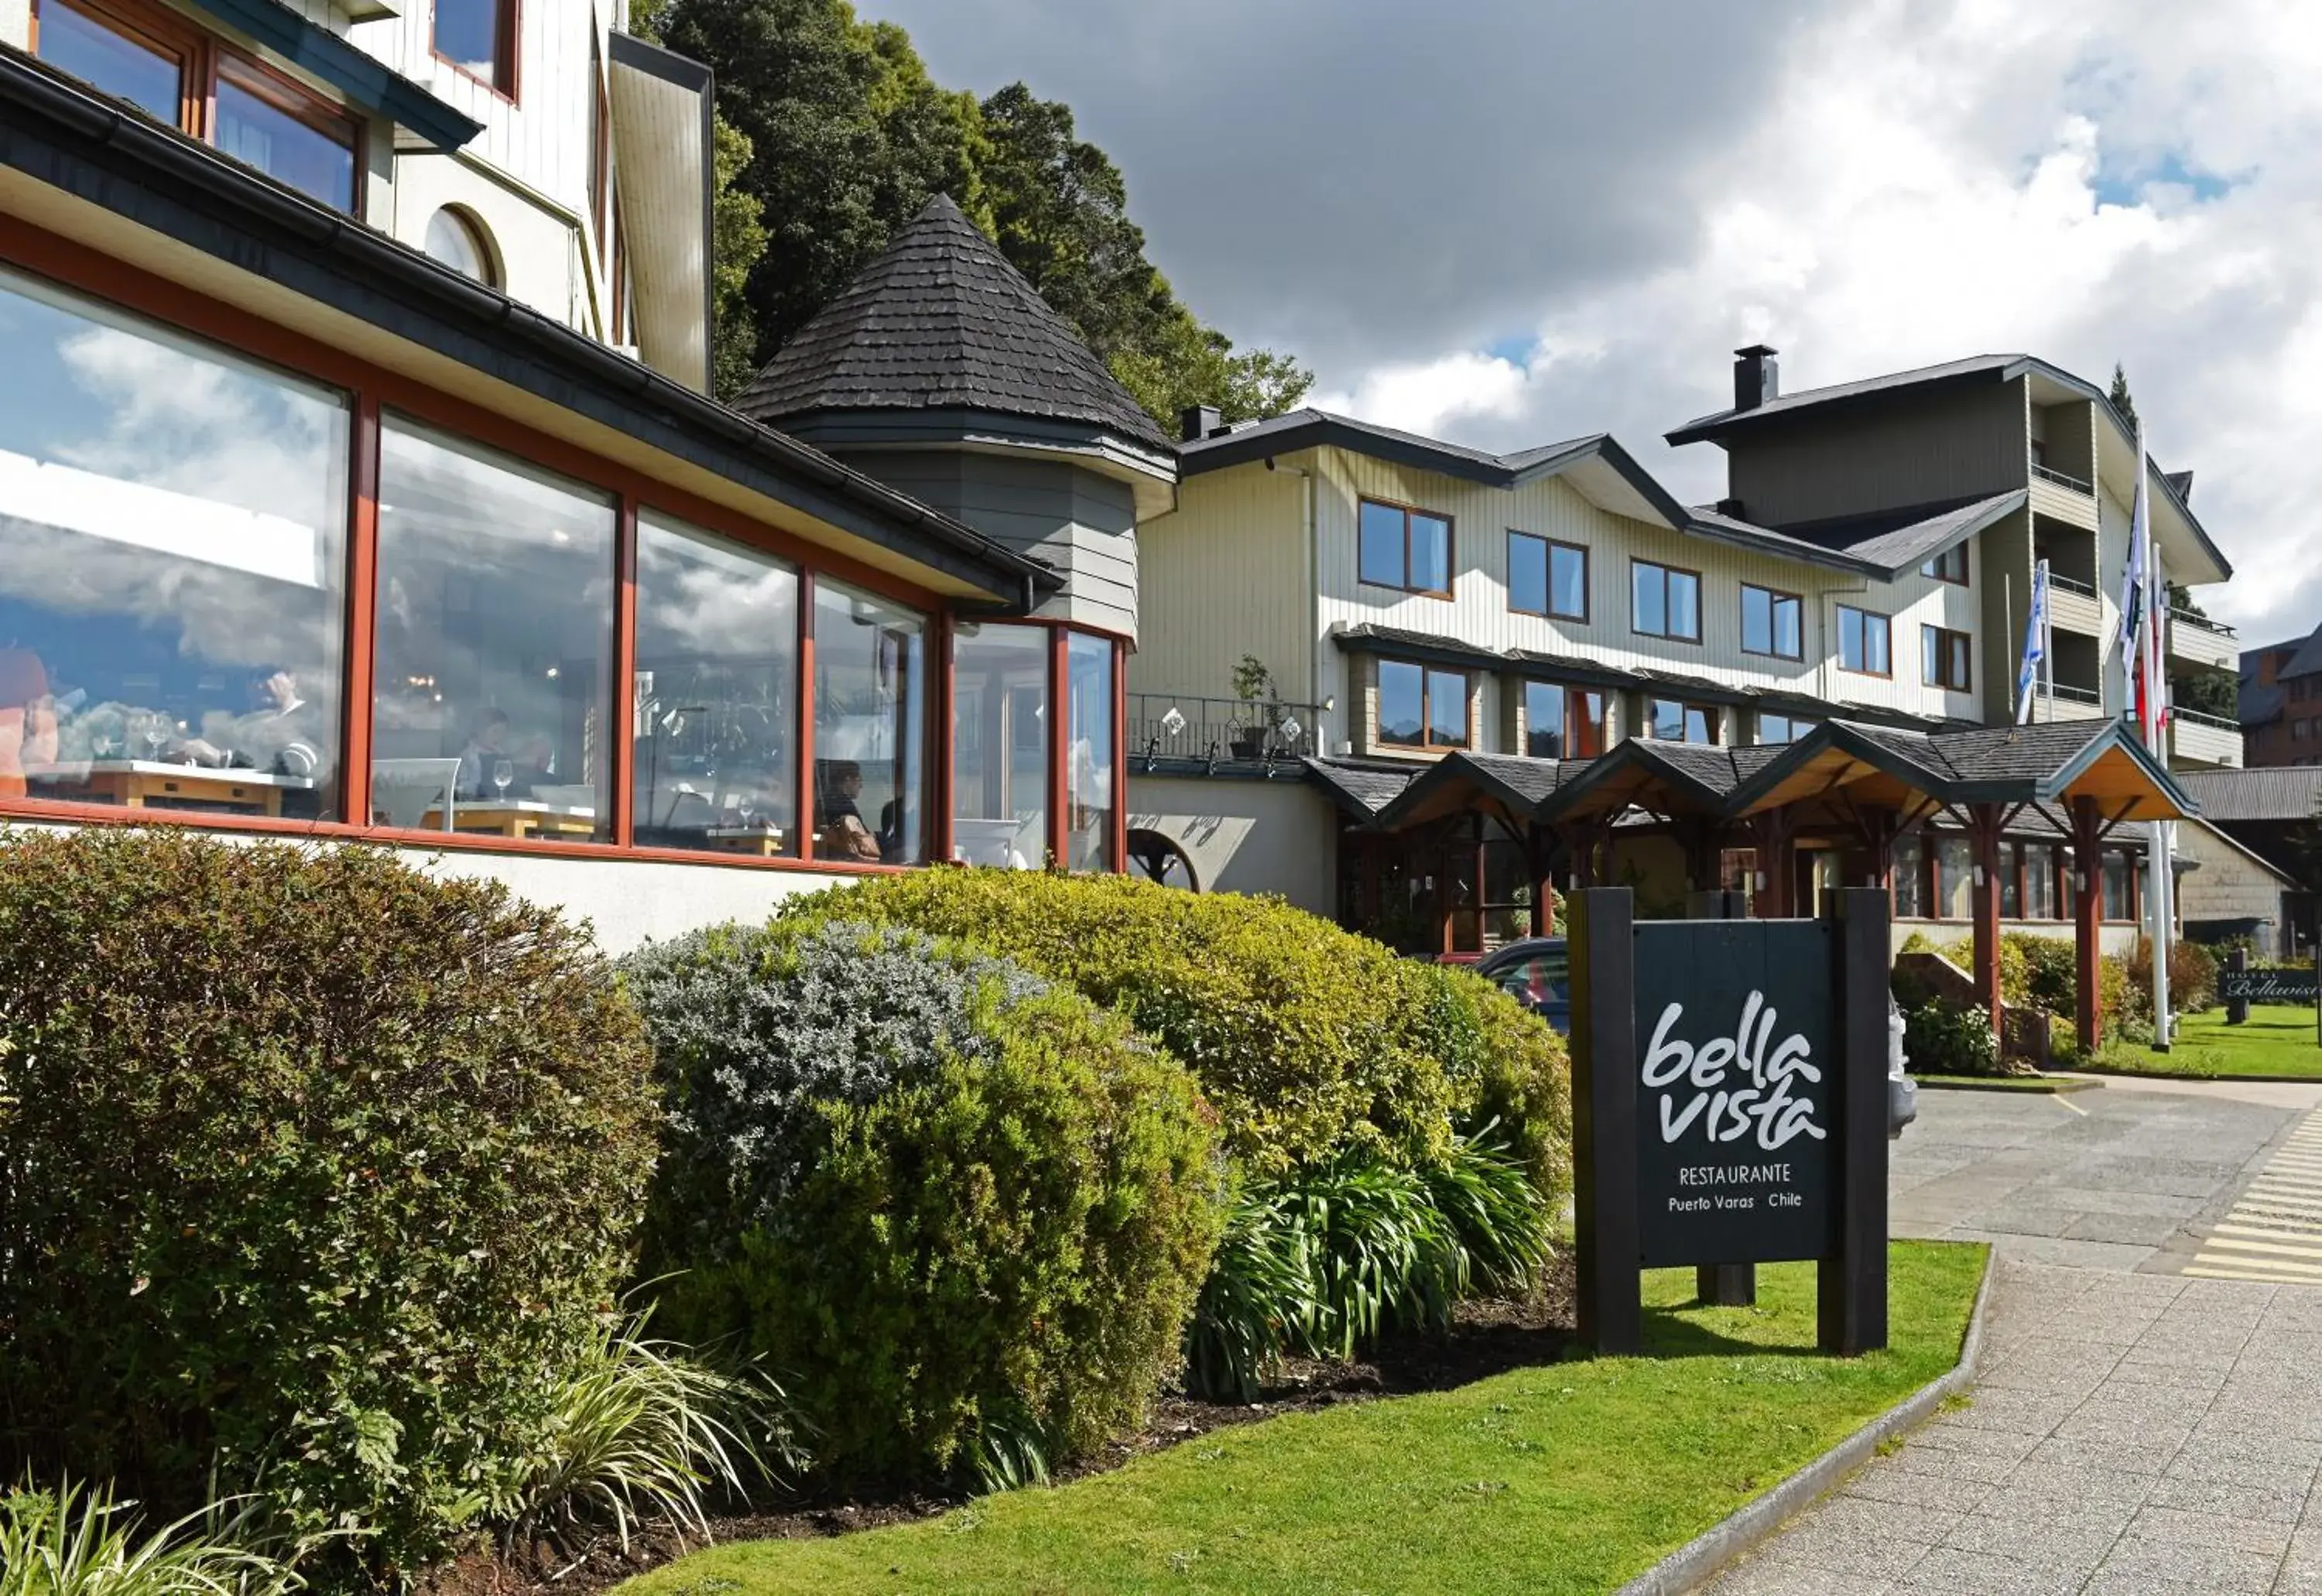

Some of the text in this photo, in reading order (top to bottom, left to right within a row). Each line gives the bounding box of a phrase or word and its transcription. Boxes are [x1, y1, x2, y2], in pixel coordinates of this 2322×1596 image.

[2226, 979, 2319, 997] Bellavist
[1642, 989, 1821, 1088] bella
[1660, 1074, 1827, 1150] vista
[1680, 1163, 1791, 1186] RESTAURANTE
[1668, 1192, 1802, 1212] Puerto Varas Chile
